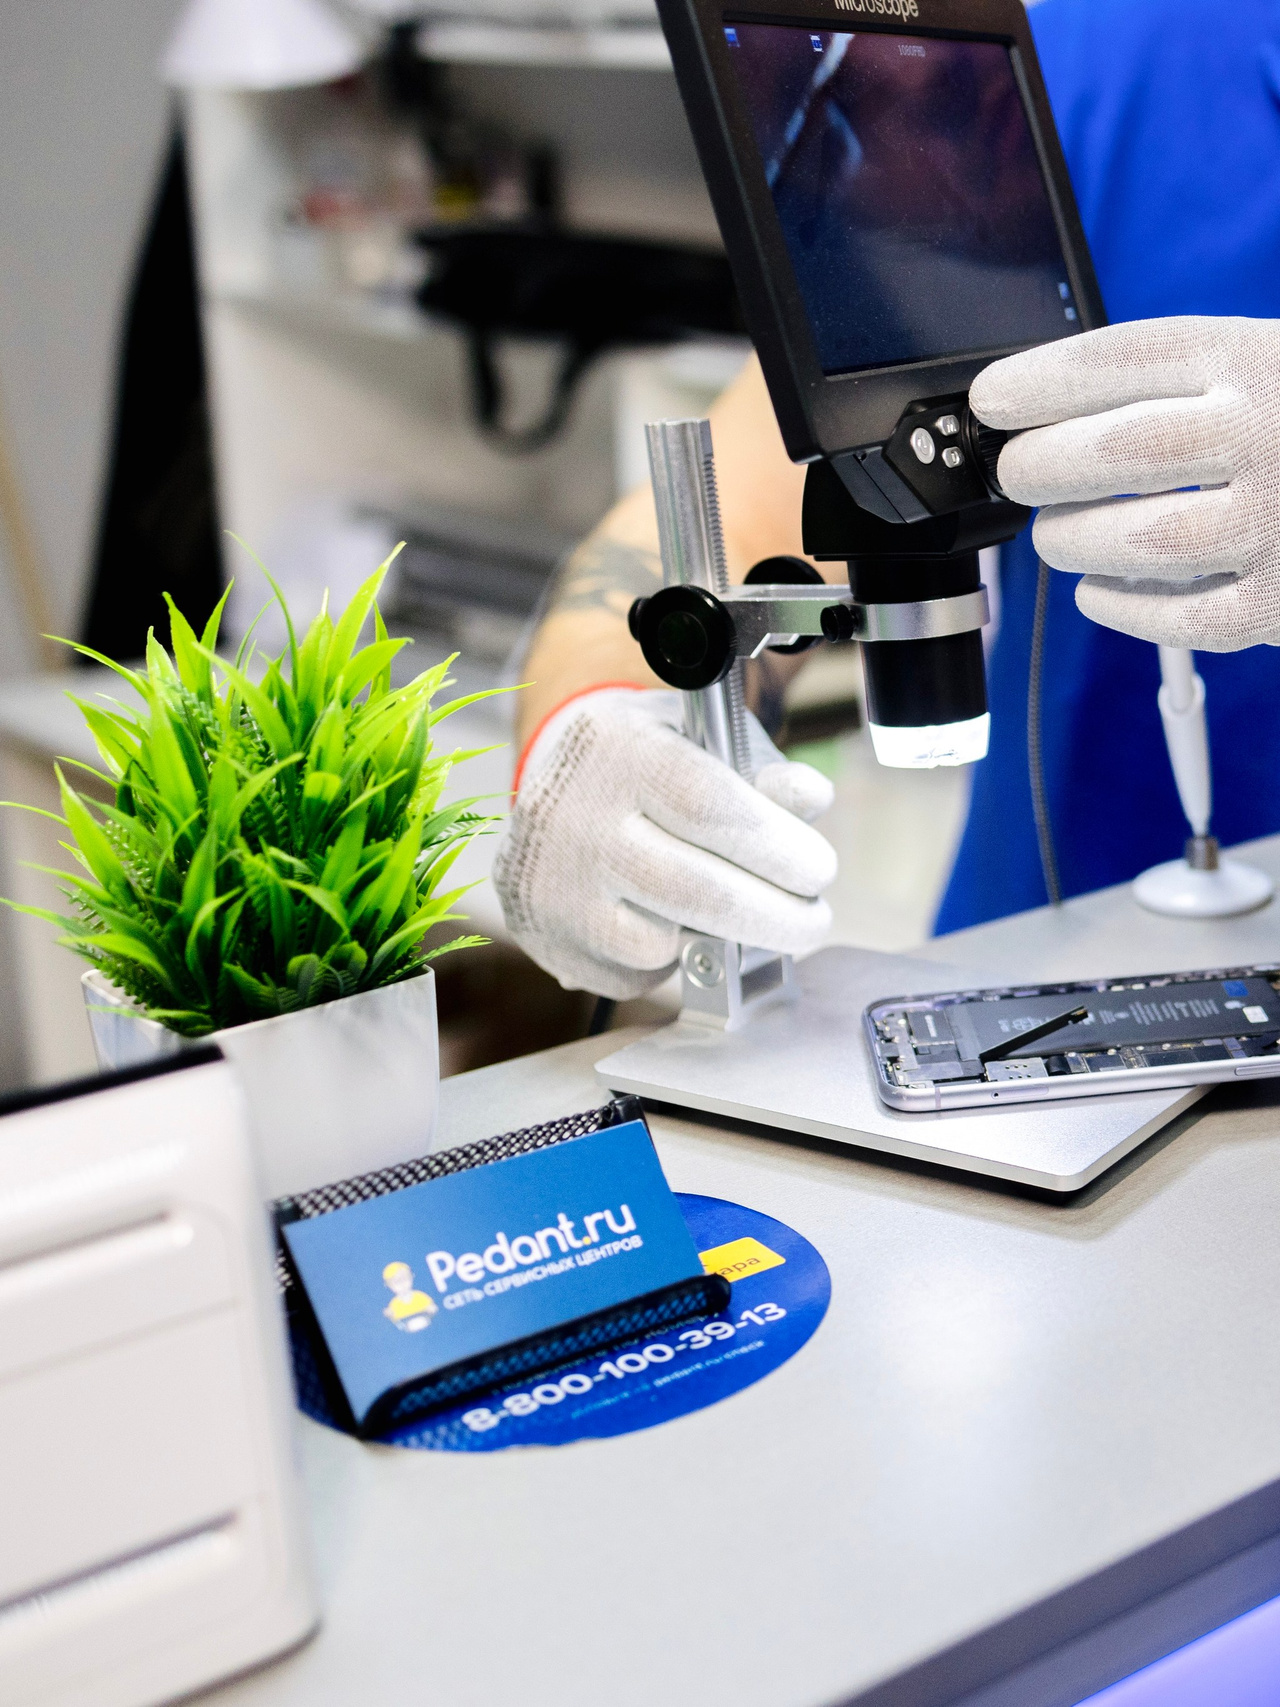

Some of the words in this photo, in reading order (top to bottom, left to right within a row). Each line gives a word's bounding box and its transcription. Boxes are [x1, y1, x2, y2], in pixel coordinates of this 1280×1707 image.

[834, 0, 919, 22] Microscope
[425, 1204, 637, 1293] Pedant.ru
[443, 1288, 485, 1310] СЕТЬ
[483, 1256, 576, 1297] СЕРВИСНЫХ
[575, 1235, 644, 1267] ЦЕНТРОВ
[461, 1302, 787, 1432] 8-800-100-39-13
